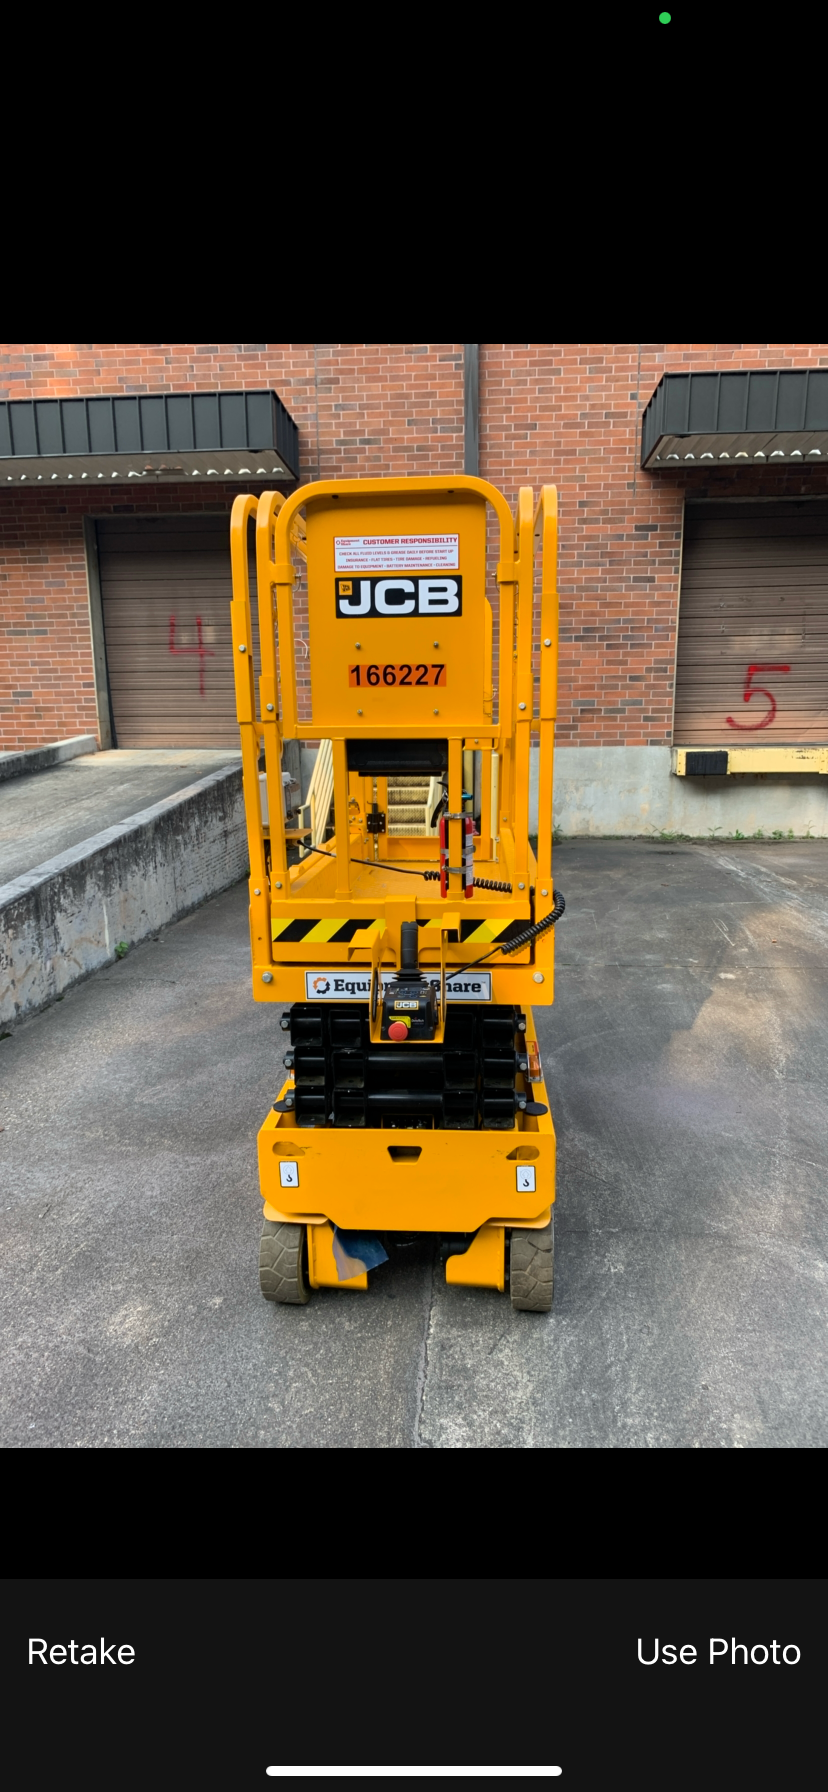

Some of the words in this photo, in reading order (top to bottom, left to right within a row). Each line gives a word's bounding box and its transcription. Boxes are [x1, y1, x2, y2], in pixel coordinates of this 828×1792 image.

[339, 579, 459, 615] JCB
[169, 614, 214, 698] 4
[351, 664, 445, 686] 166227
[725, 663, 791, 731] 5
